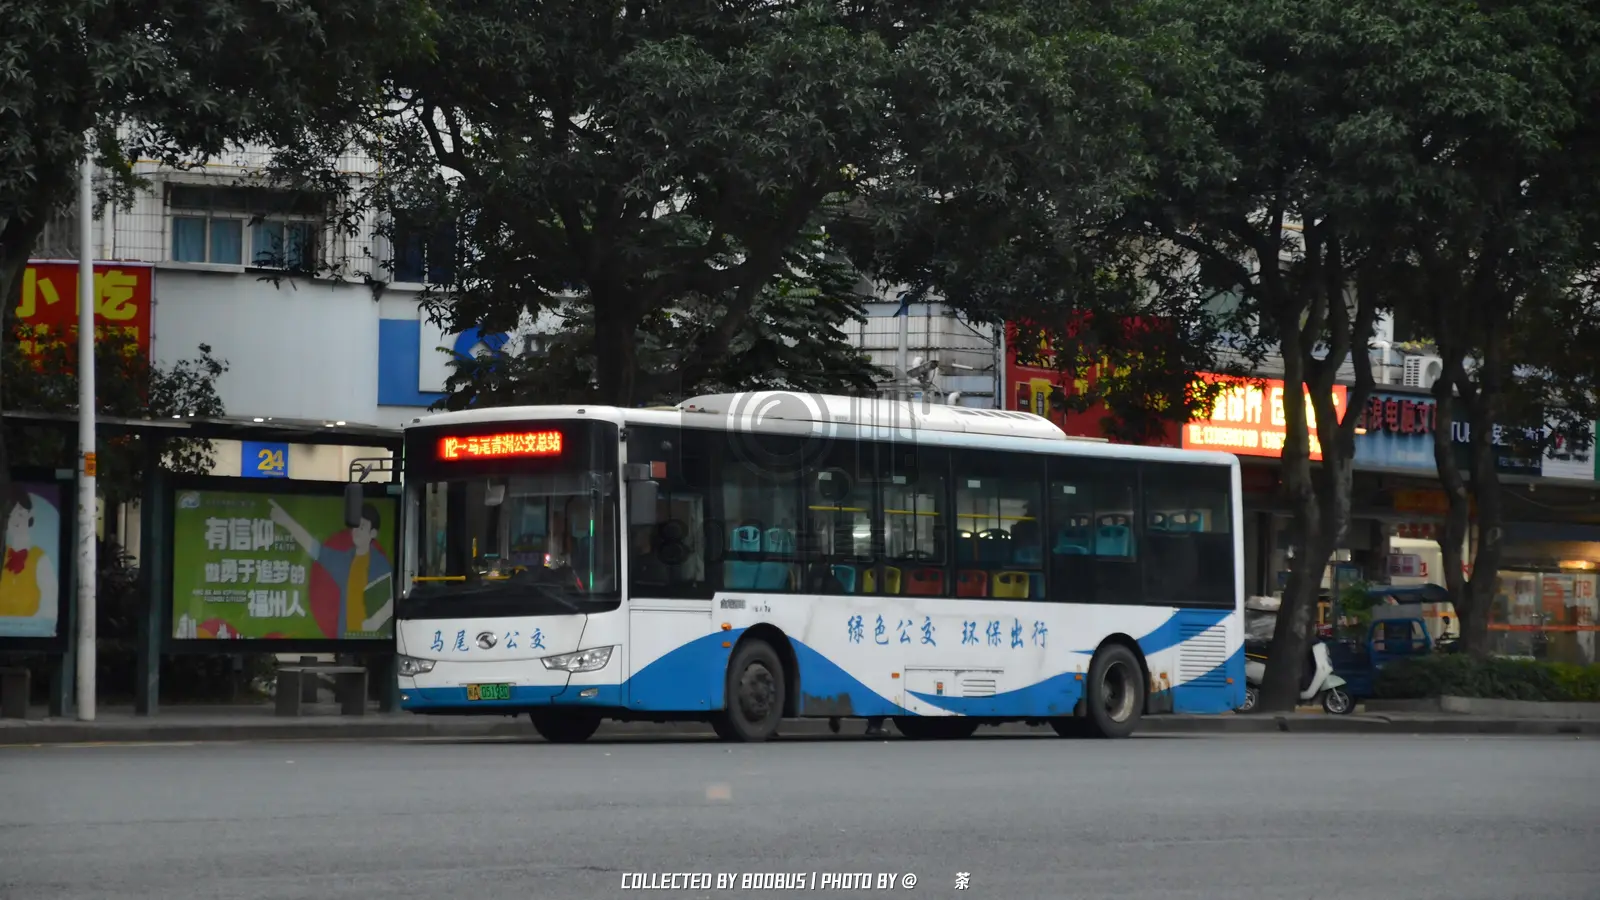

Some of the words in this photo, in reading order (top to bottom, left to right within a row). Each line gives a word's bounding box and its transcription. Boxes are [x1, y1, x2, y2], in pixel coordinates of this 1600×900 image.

[15, 268, 138, 320] 小吃
[468, 432, 560, 455] 马尾青洲公交总站
[257, 449, 285, 471] 24
[204, 516, 275, 552] 有信仰
[205, 558, 305, 585] 做勇于追梦的
[247, 589, 306, 618] 福州人
[430, 630, 470, 652] 马尾
[503, 627, 547, 650] 公交
[848, 614, 937, 647] 绿色公交
[961, 618, 1048, 649] 环保出行
